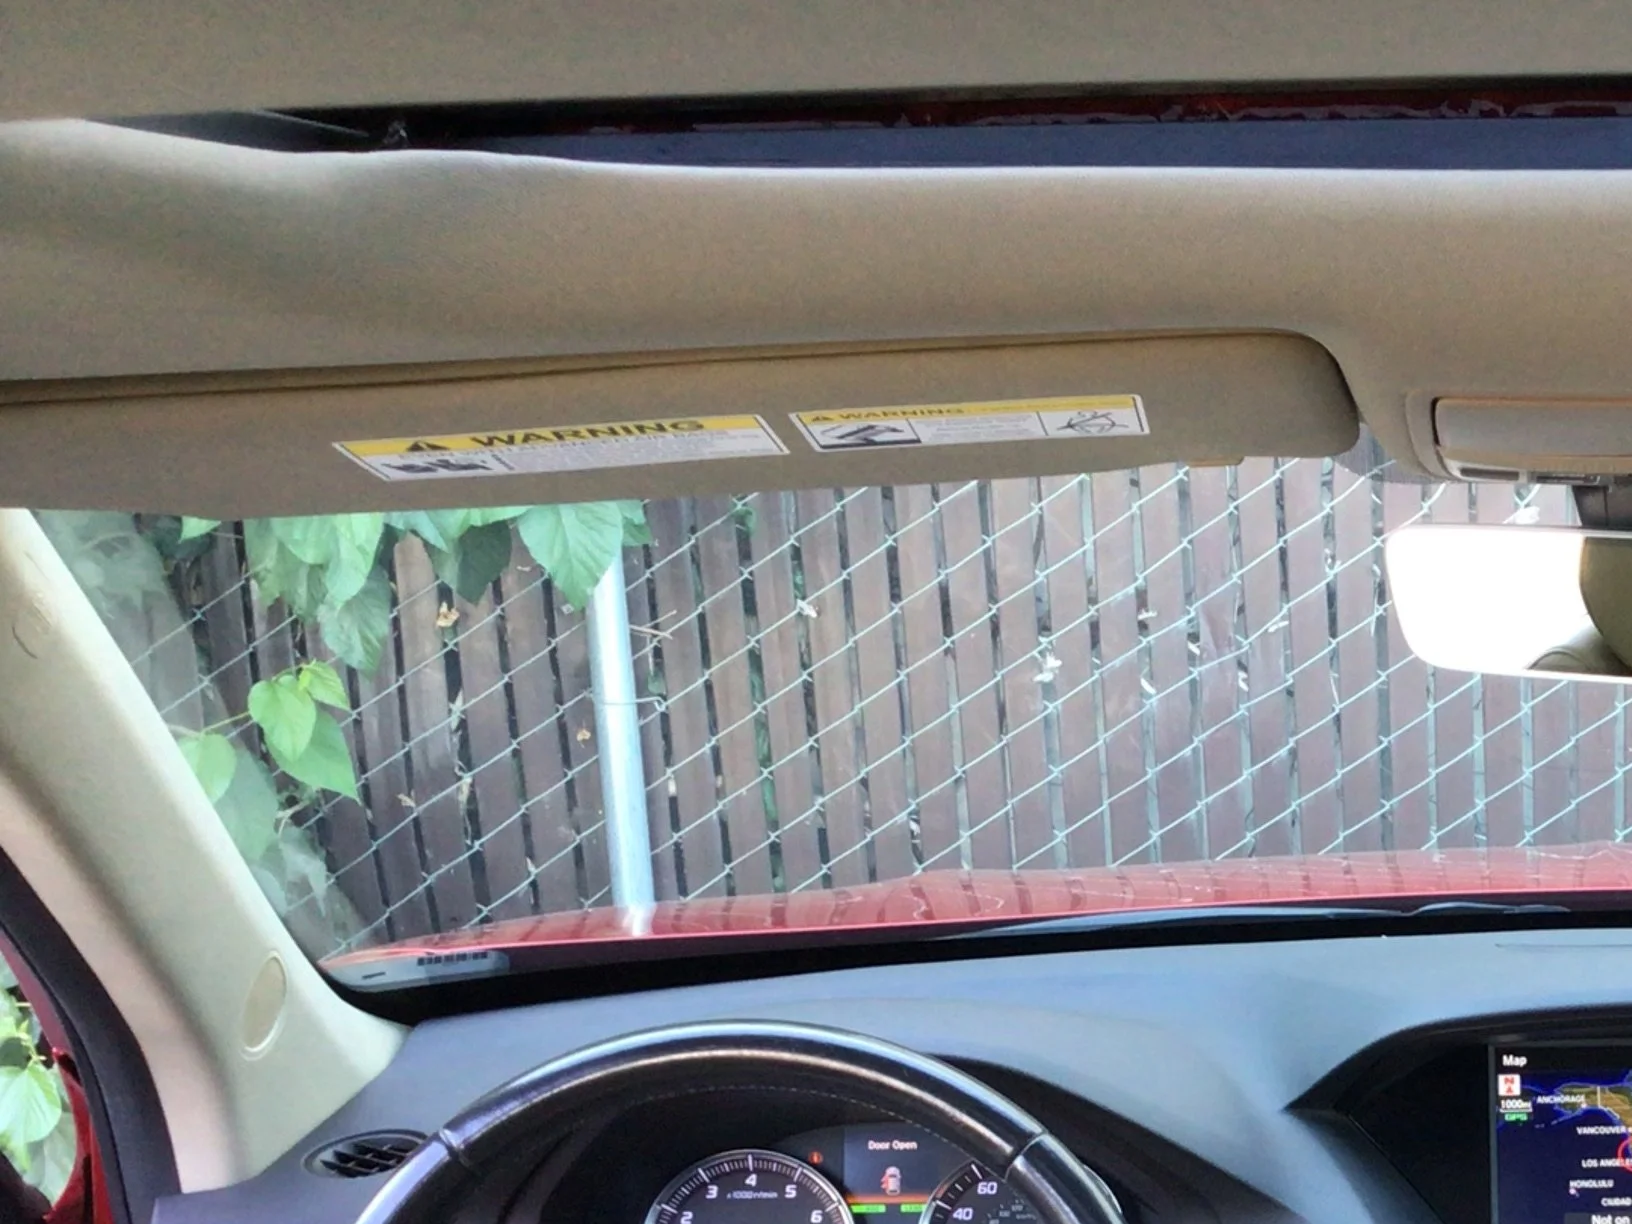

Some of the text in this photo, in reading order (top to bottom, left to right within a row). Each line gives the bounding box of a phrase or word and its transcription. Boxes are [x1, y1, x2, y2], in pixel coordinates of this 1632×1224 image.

[839, 407, 965, 421] WARNING
[470, 419, 704, 448] WARNING
[1502, 1055, 1527, 1068] Map
[1536, 1094, 1586, 1104] ANCHORAGE
[1576, 1126, 1626, 1135] VANCOUVER
[868, 1139, 918, 1151] Door Open
[1582, 1159, 1597, 1168] LOS
[745, 1174, 758, 1188] 4
[1569, 1180, 1614, 1188] HONOLULU
[706, 1185, 719, 1199] 3
[784, 1185, 797, 1199] 5
[977, 1182, 998, 1195] 60
[1601, 1198, 1632, 1206] CIUDAD
[680, 1212, 693, 1224] 2
[810, 1210, 823, 1223] 6
[953, 1208, 973, 1220] 40
